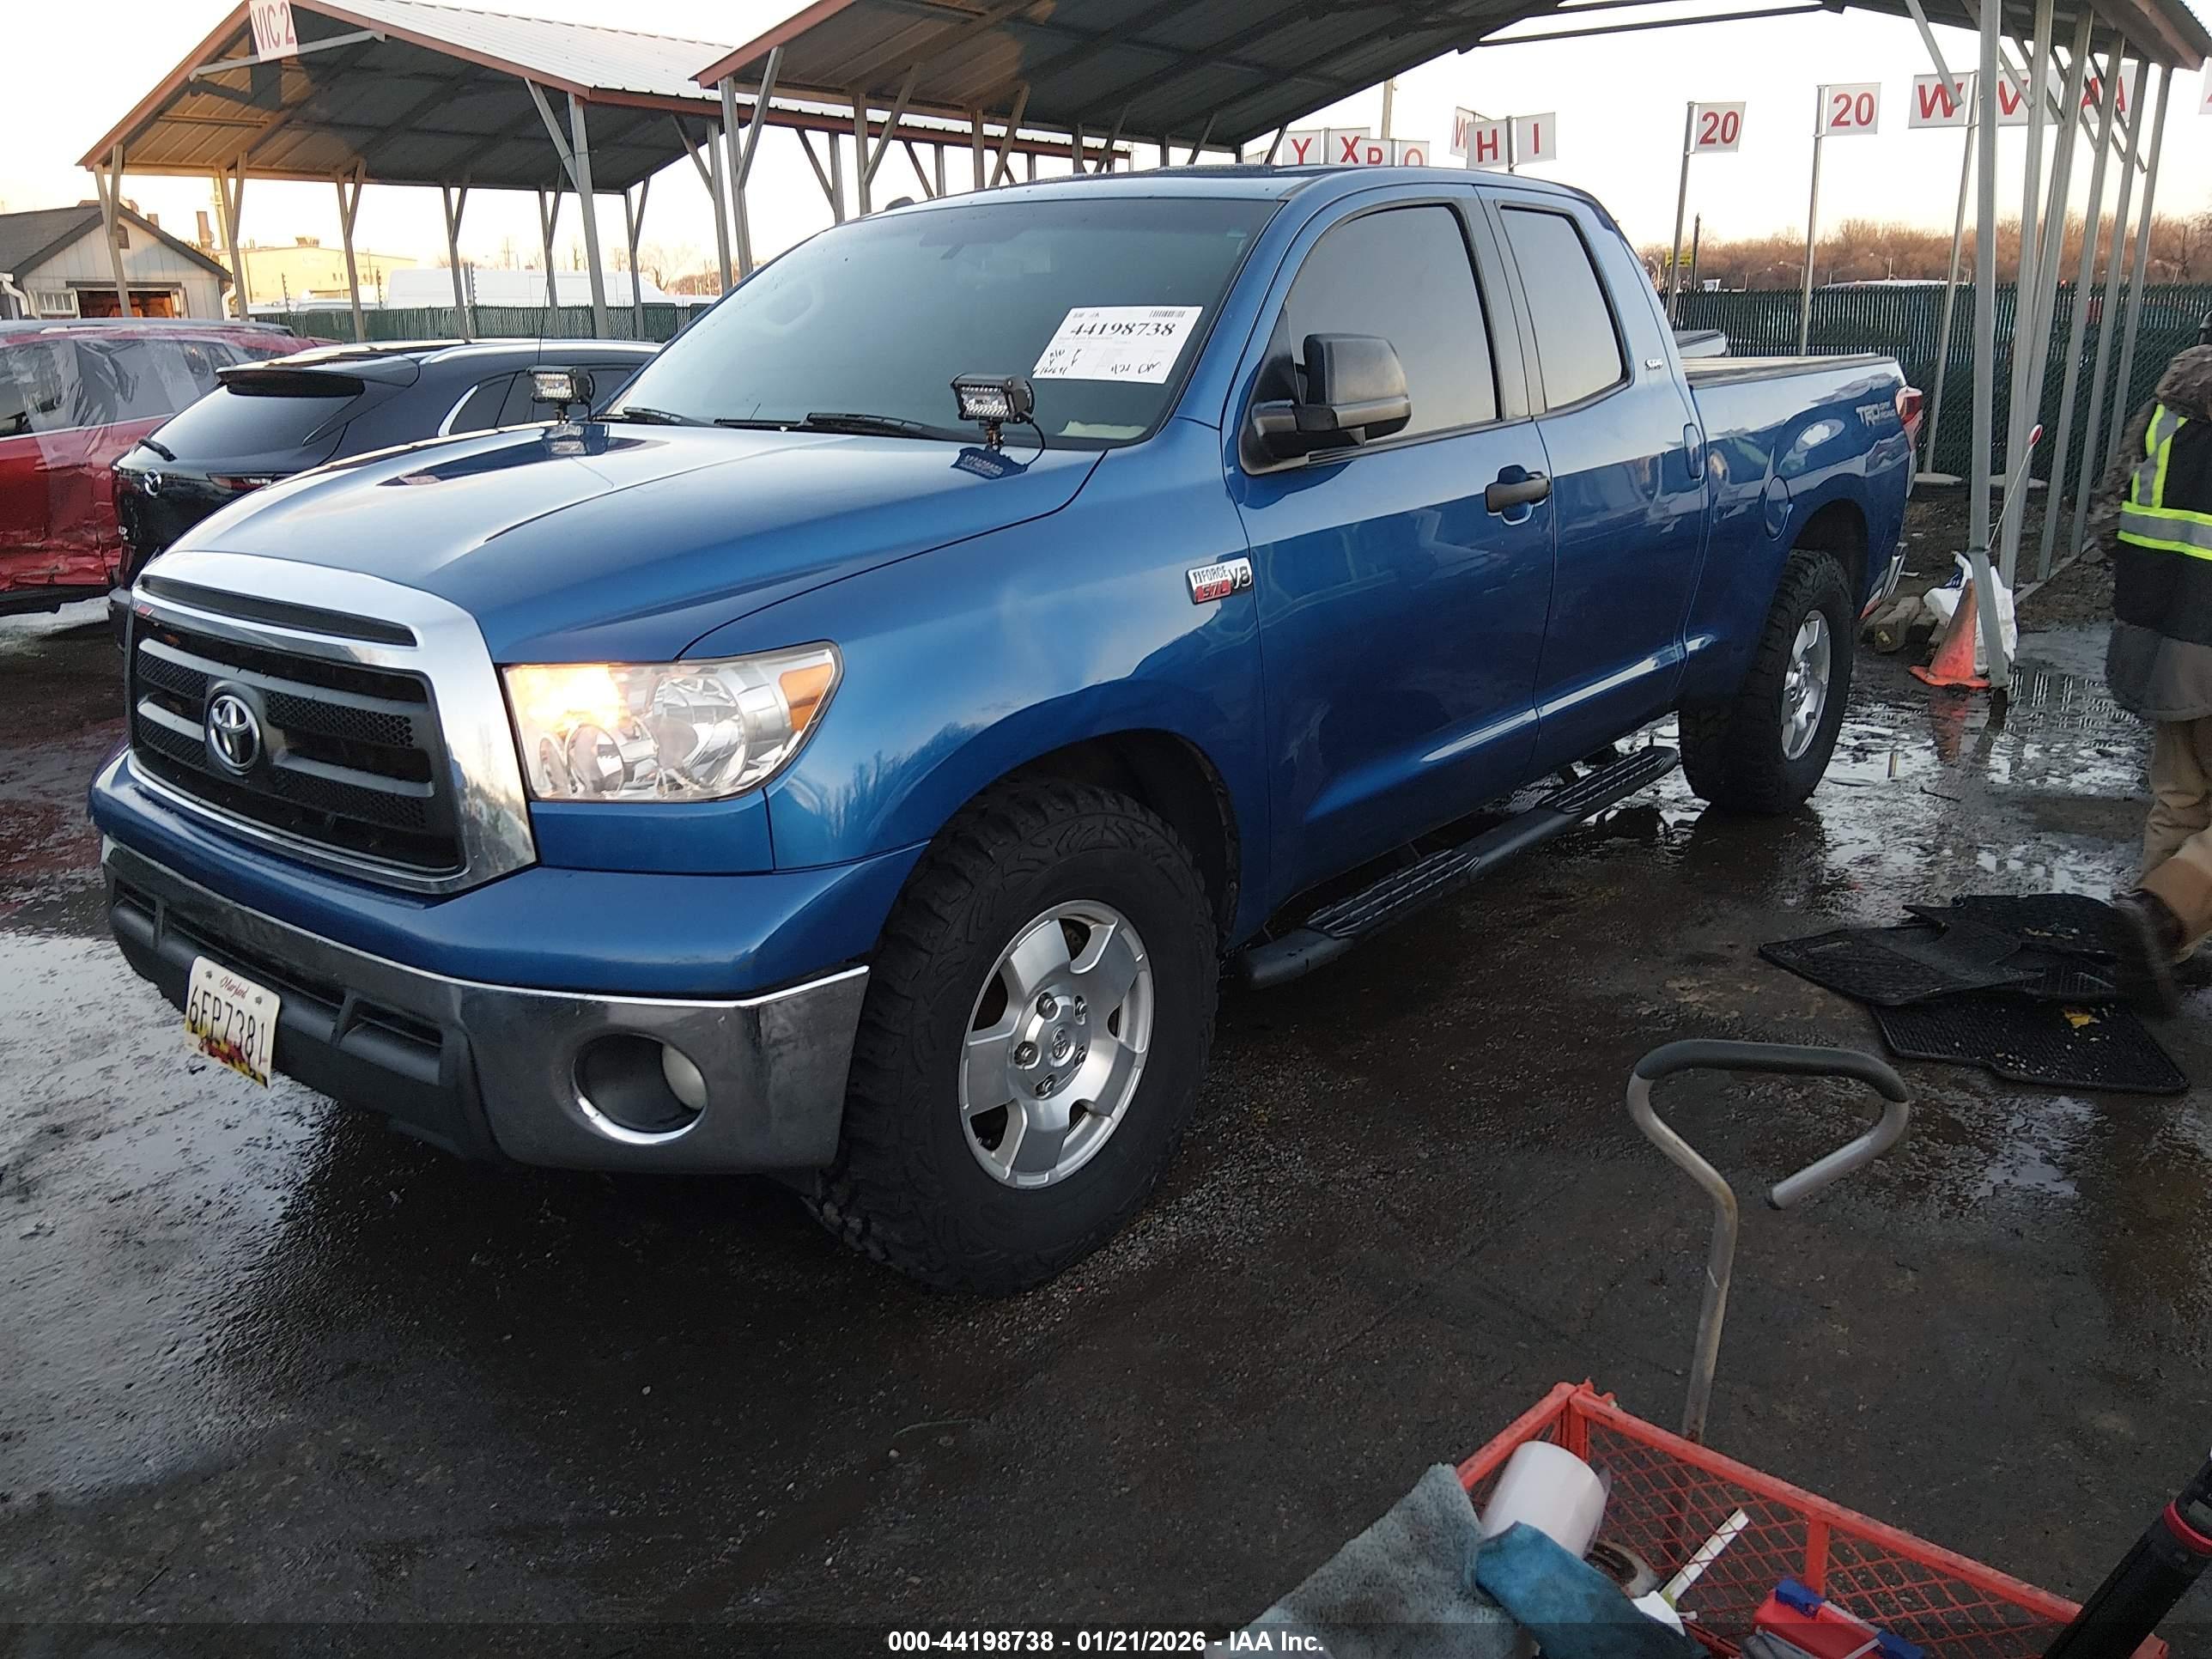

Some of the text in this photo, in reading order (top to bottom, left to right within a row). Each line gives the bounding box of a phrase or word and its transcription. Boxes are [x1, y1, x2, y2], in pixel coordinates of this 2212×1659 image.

[252, 2, 295, 51] VIC 2
[1830, 92, 1875, 126] 20
[1917, 82, 1964, 118] W
[1476, 123, 1540, 163] H I
[1698, 111, 1739, 144] 20
[1291, 135, 1361, 165] Y X
[1071, 322, 1176, 337] 44198738
[1229, 565, 1251, 591] V8
